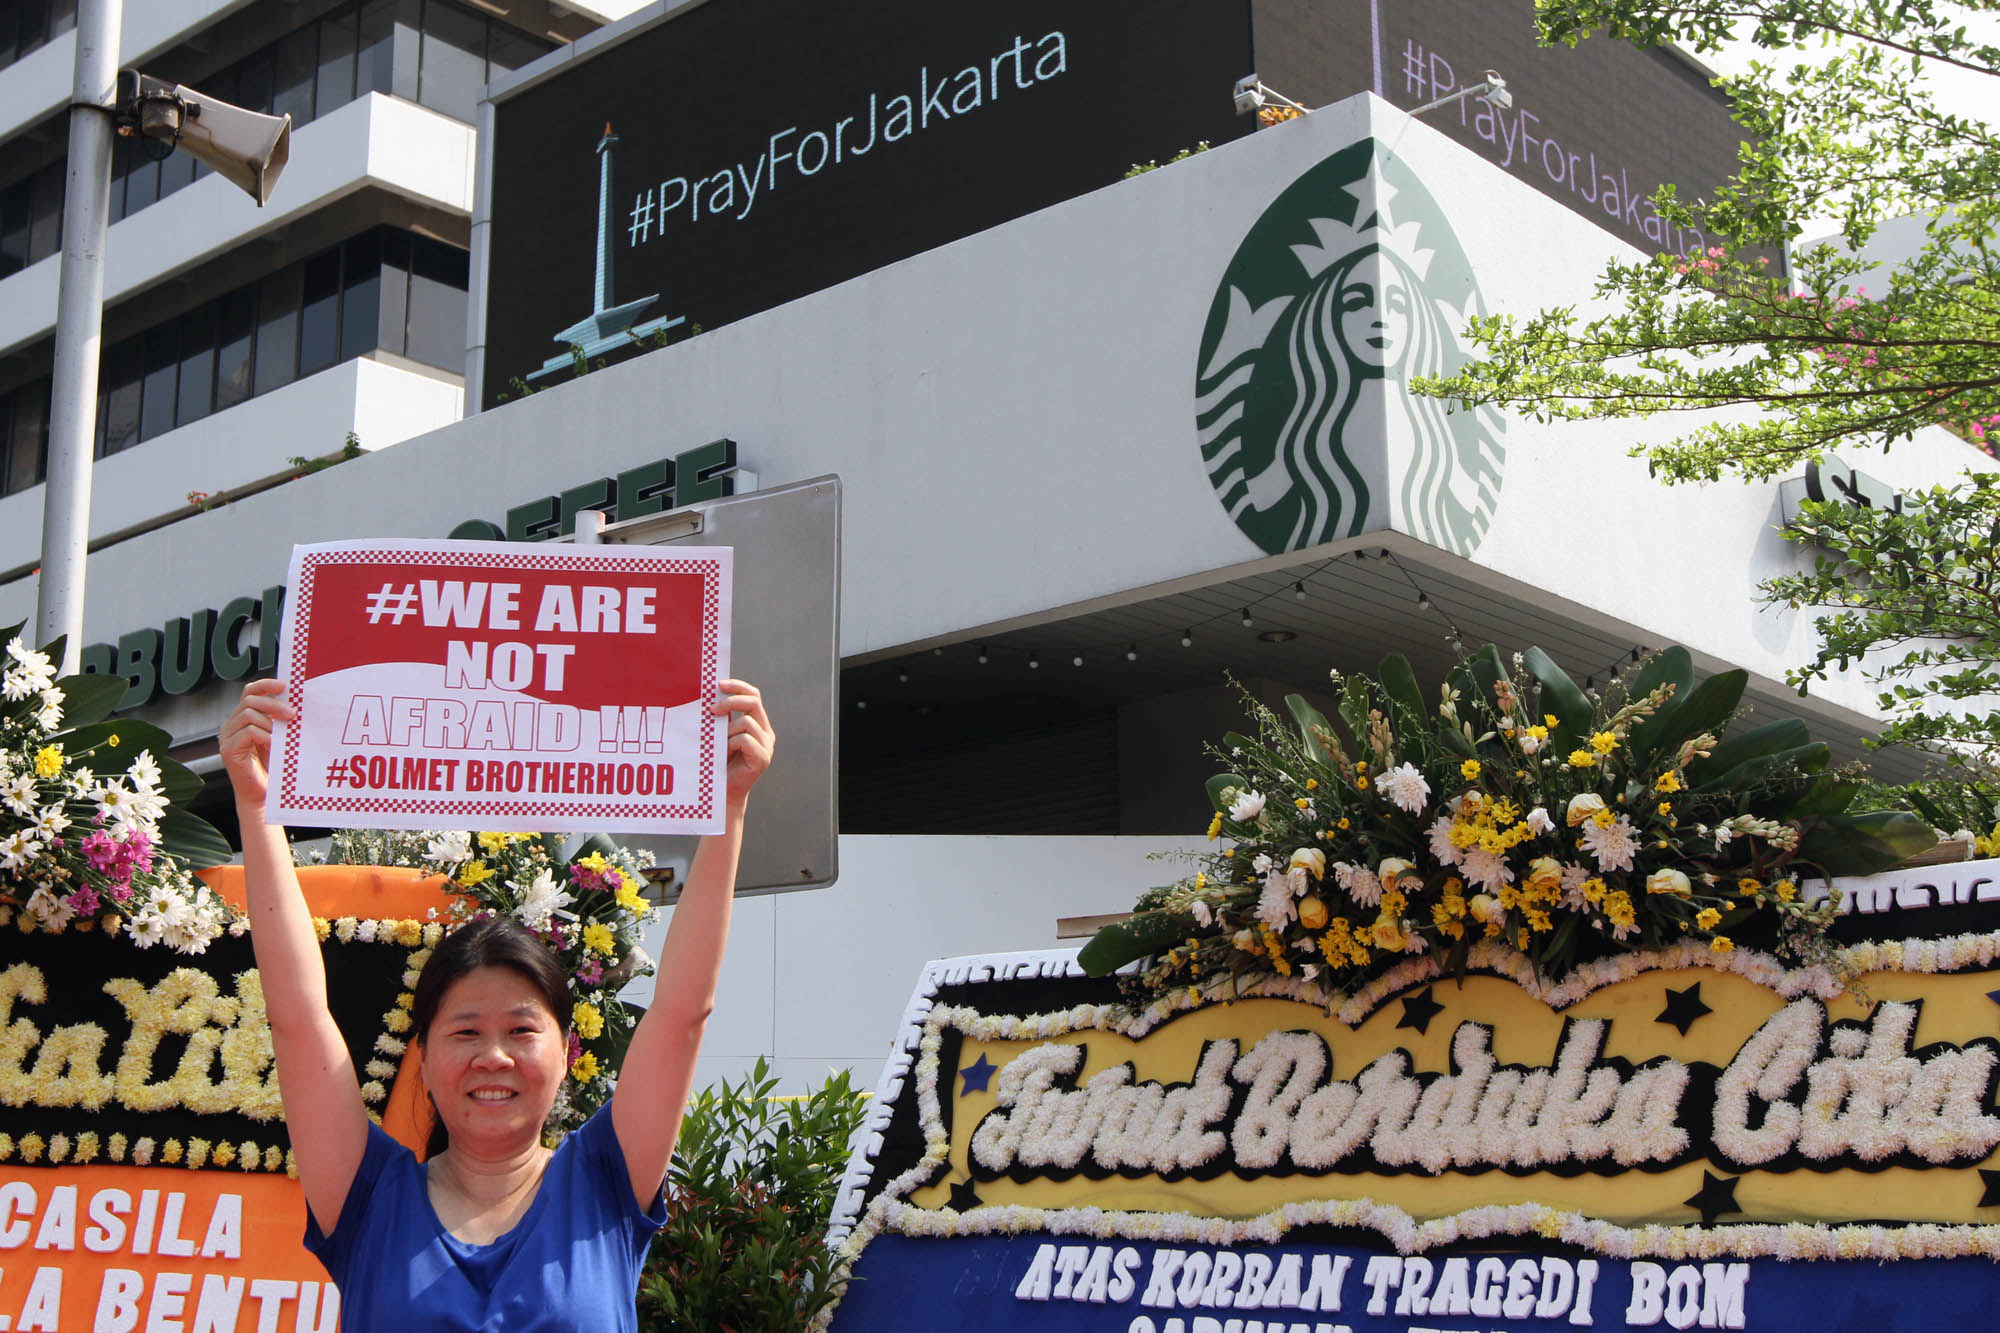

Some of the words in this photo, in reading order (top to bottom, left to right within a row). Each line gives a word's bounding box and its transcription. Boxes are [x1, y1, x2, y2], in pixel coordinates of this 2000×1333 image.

[627, 30, 1067, 248] #PrayForJakarta
[365, 579, 521, 631] #WE
[534, 585, 657, 634] ARE
[444, 640, 576, 692] NOT
[341, 694, 582, 752] AFRAID
[598, 705, 667, 754] !!!
[325, 754, 460, 793] #SOLMET
[466, 760, 675, 796] BROTHERHOOD
[972, 1038, 1236, 1173] Turut
[1231, 1018, 1692, 1175] Berduka
[1711, 996, 2000, 1165] Cita
[0, 1181, 243, 1259] CASILA
[1015, 1243, 1142, 1303] ATAS
[1140, 1248, 1353, 1312] KORBAN
[1363, 1255, 1600, 1326] TRAGEDI
[1625, 1260, 1751, 1330] BOM
